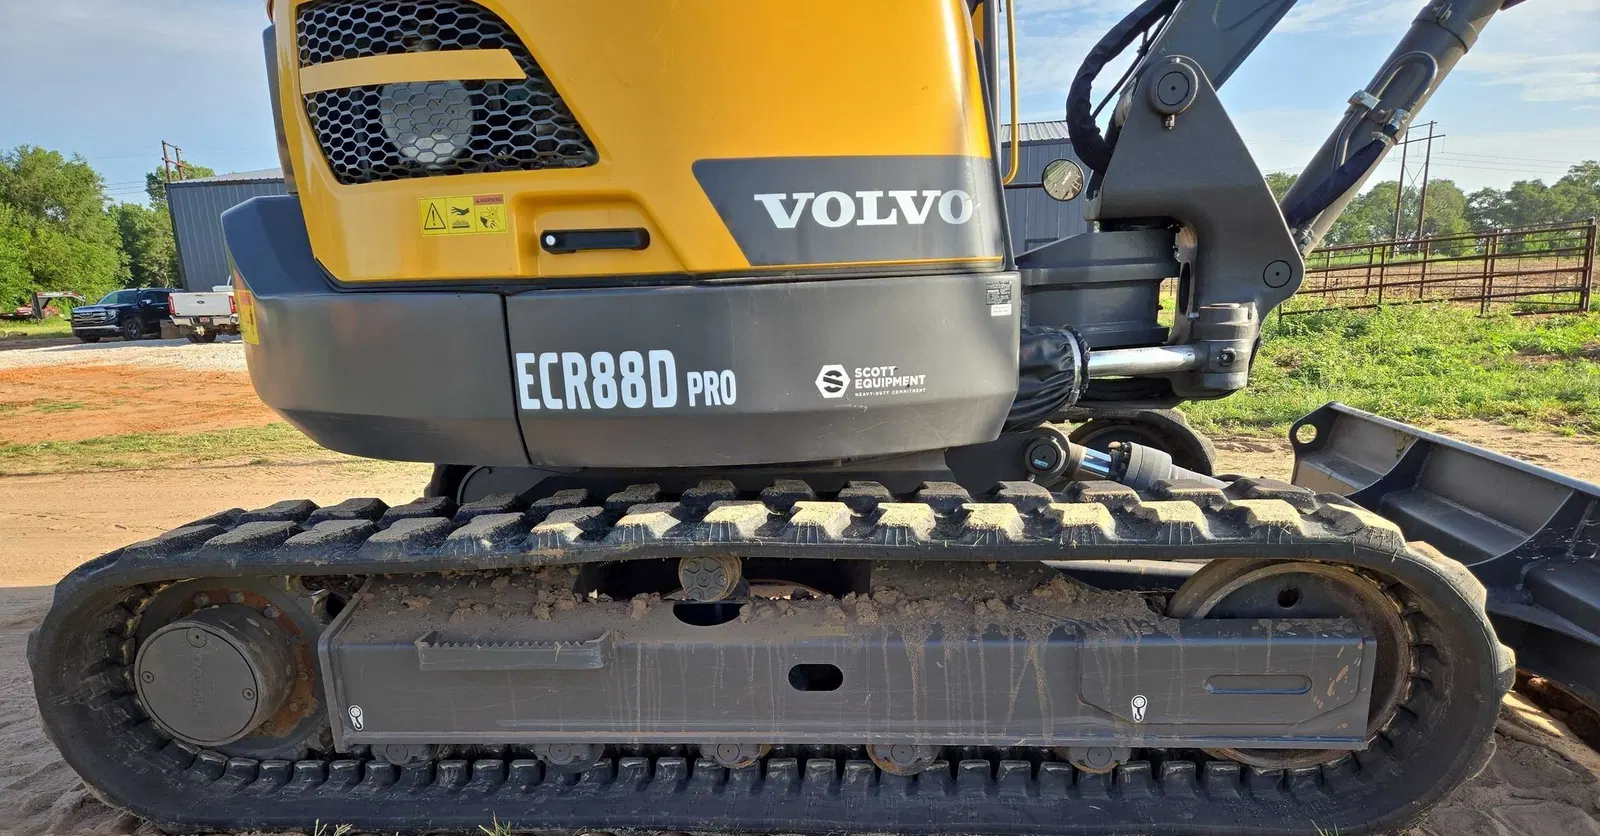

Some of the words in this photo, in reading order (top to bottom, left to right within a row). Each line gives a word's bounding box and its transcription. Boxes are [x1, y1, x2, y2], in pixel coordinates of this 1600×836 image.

[753, 189, 974, 229] VOLVO
[515, 349, 678, 410] ECR88D
[686, 369, 737, 407] PRO
[854, 365, 897, 378] SCOTT
[854, 374, 926, 389] EQUIPMENT
